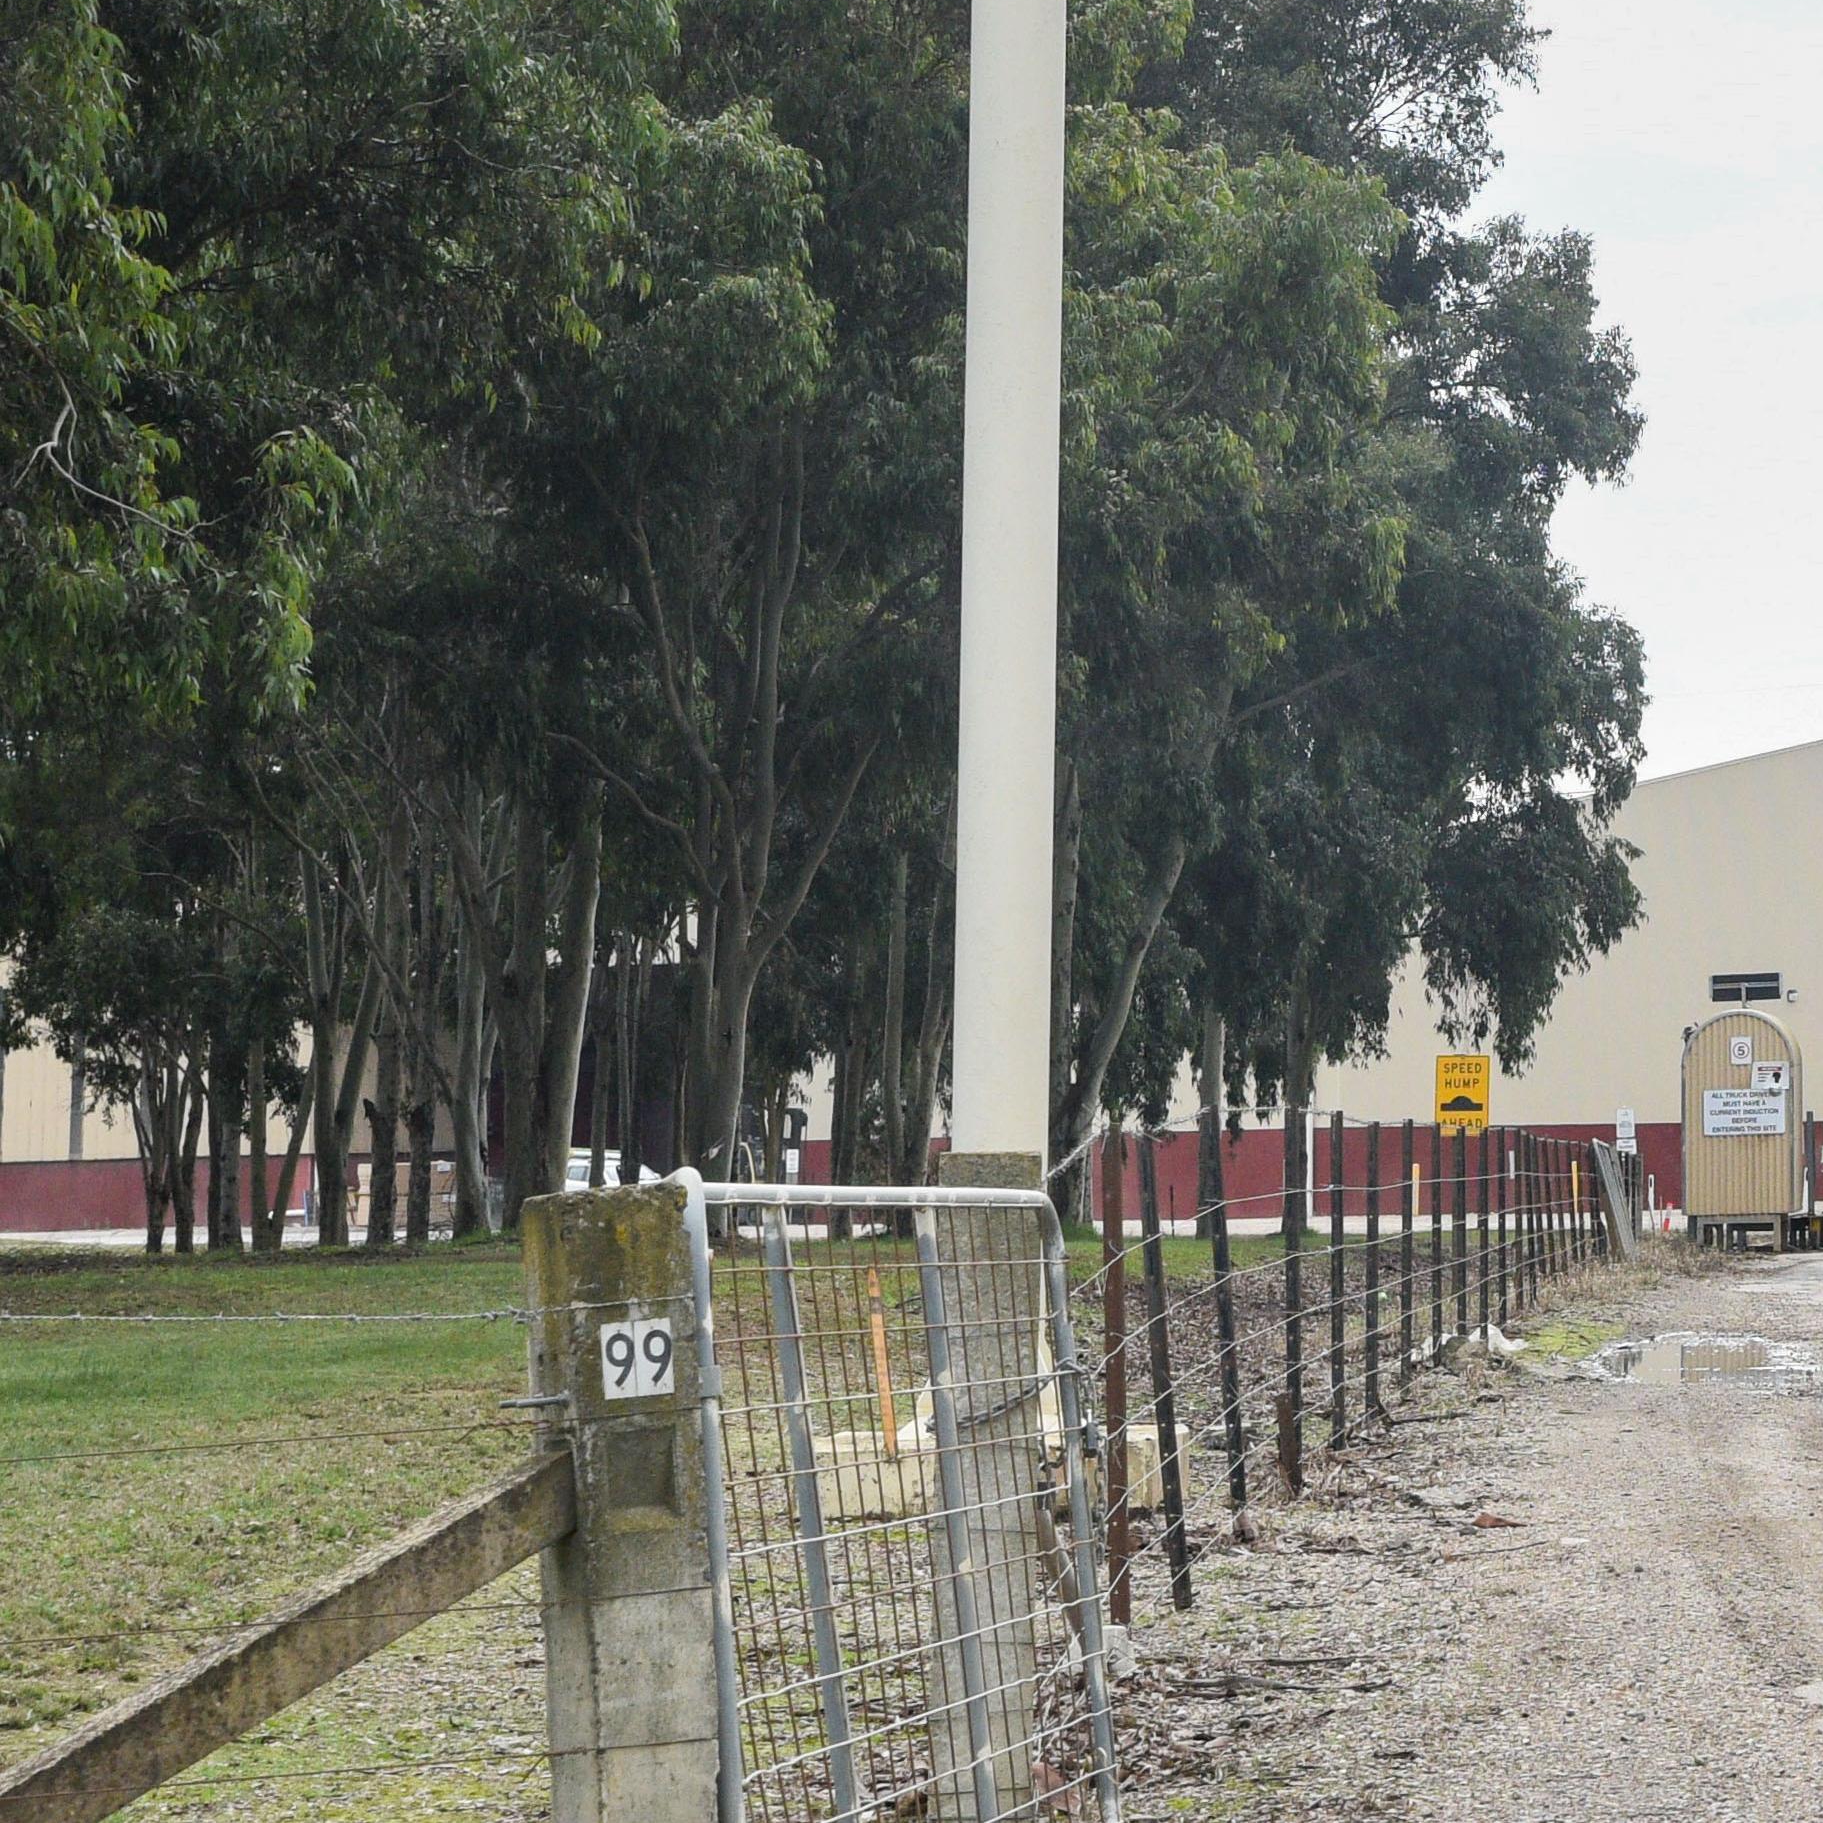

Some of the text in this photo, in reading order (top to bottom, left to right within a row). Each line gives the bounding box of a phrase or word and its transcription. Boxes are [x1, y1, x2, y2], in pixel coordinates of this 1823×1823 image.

[1737, 1046, 1746, 1056] 5
[1444, 1063, 1482, 1074] SPEED
[1445, 1078, 1480, 1089] HUMP
[1441, 1118, 1482, 1128] AHEAD
[605, 1329, 672, 1387] 99
